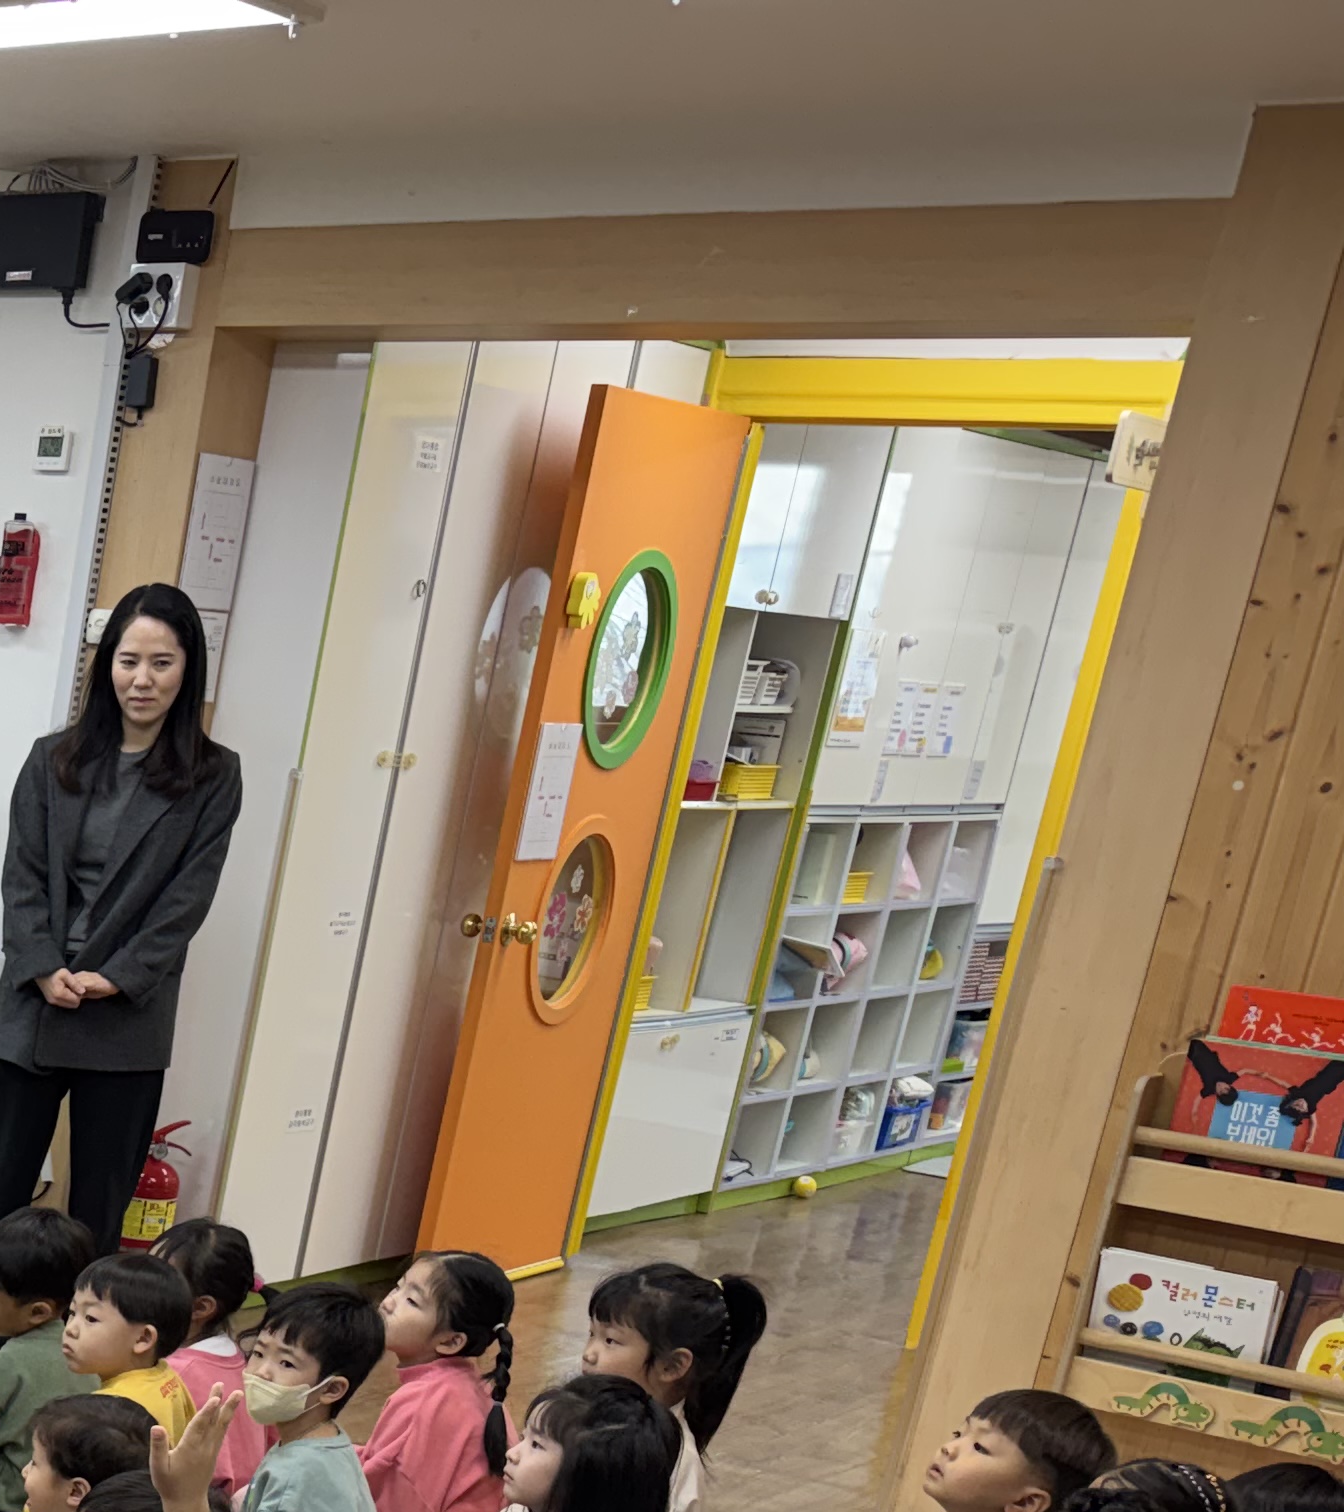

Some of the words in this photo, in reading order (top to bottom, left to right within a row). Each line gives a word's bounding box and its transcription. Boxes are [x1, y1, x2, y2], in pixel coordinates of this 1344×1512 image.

[1230, 1100, 1264, 1125] 이것
[1264, 1105, 1281, 1128] 좀
[1161, 1279, 1198, 1302] 컬러
[1202, 1284, 1256, 1311] 몬스터
